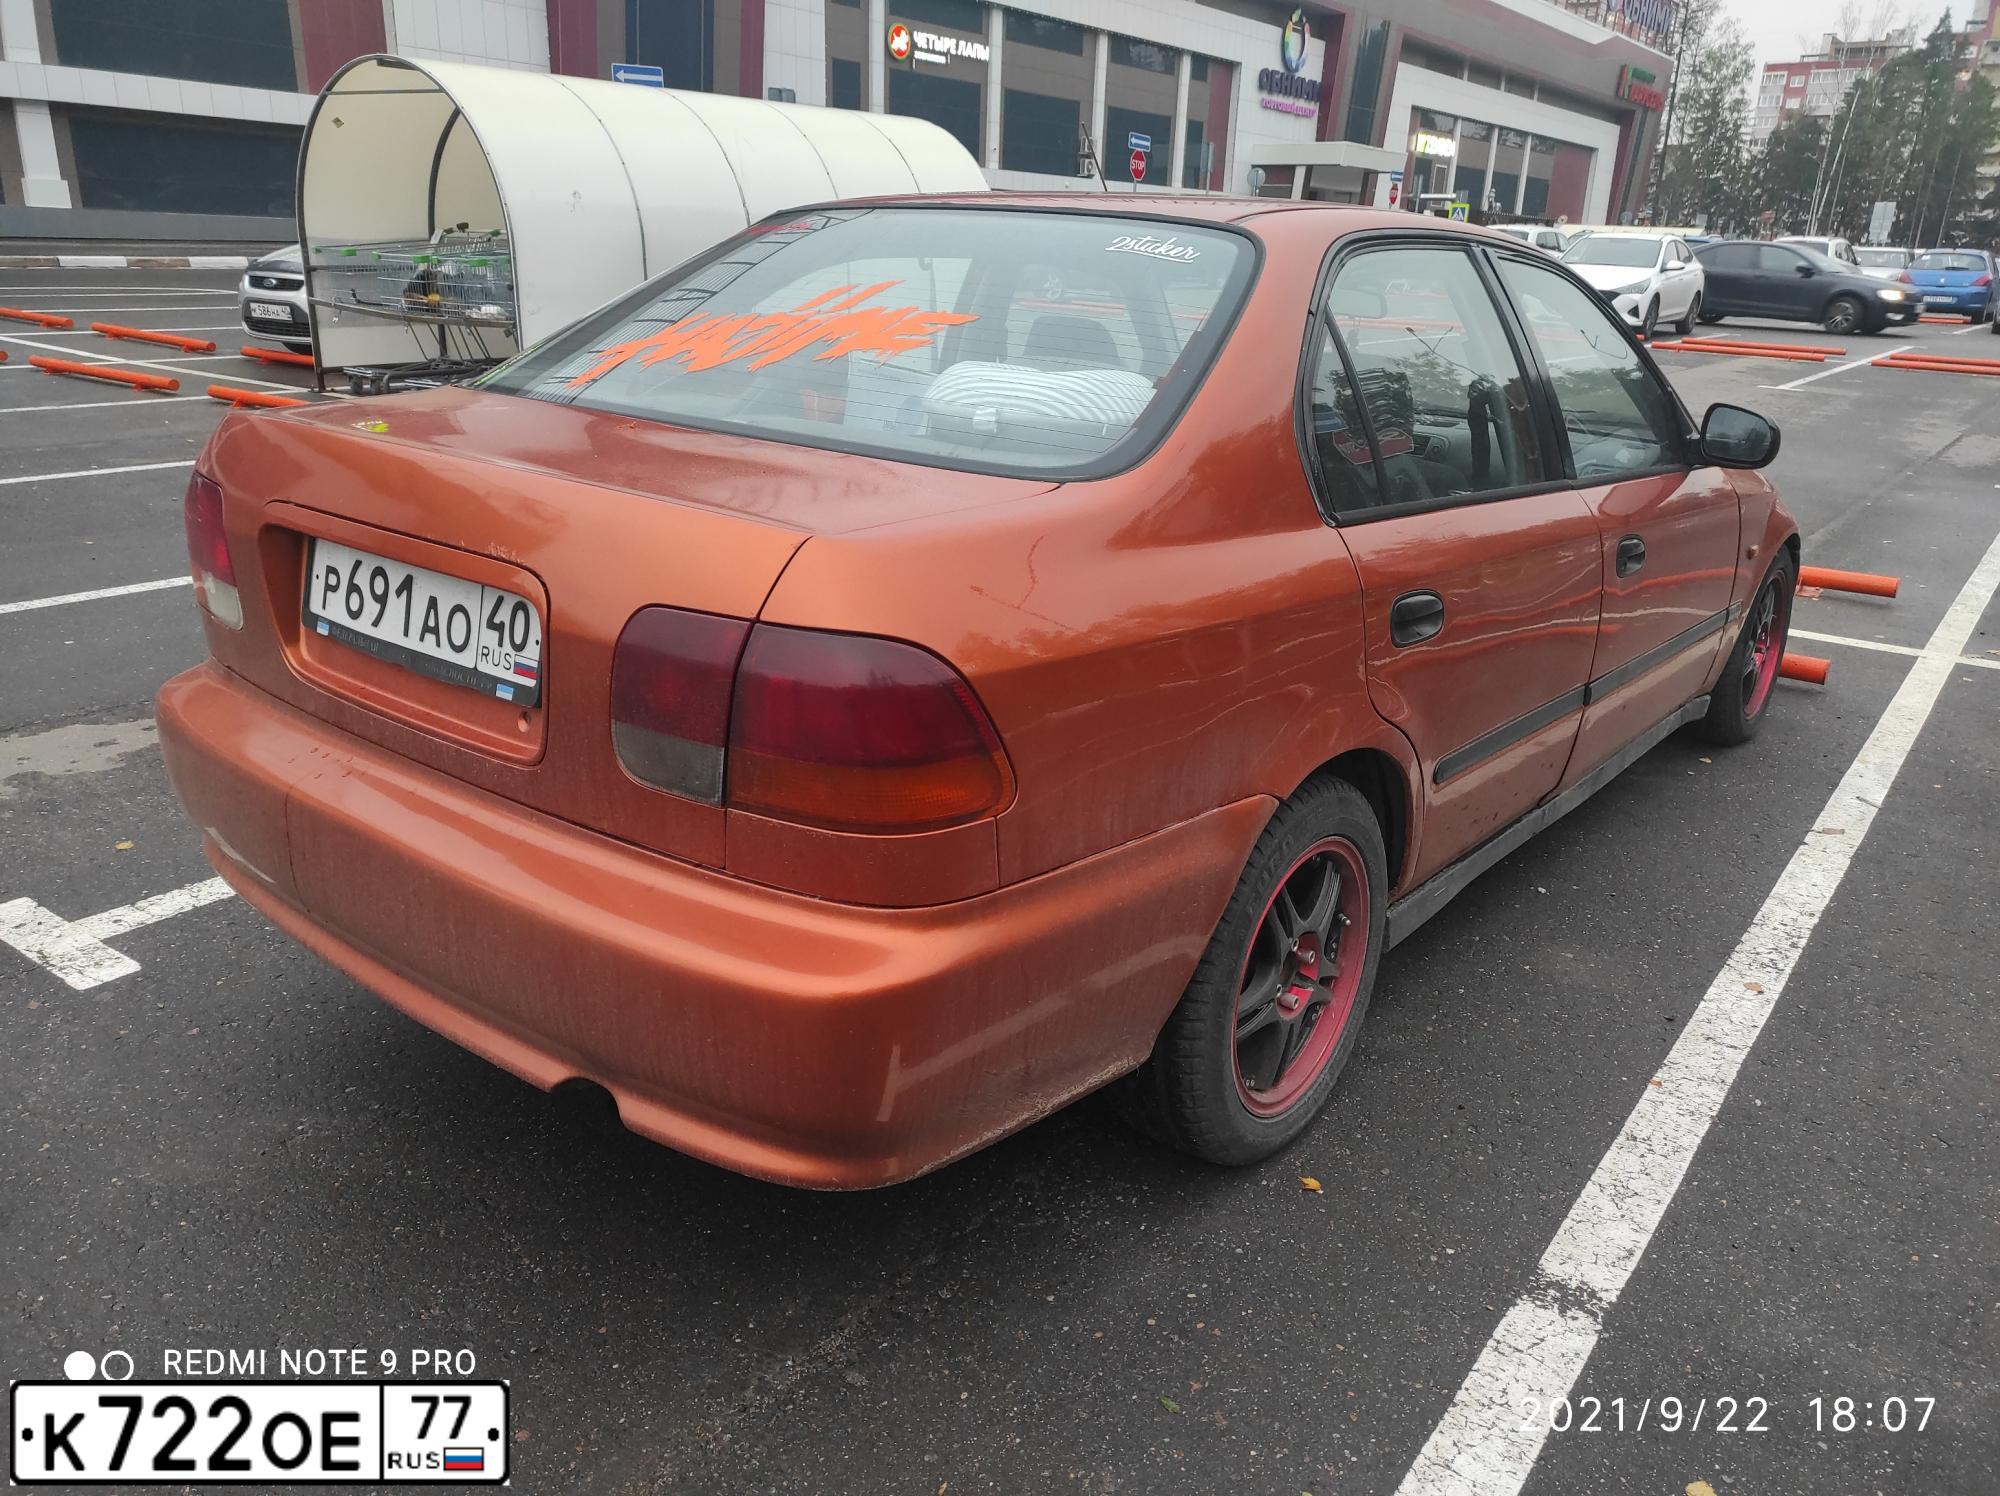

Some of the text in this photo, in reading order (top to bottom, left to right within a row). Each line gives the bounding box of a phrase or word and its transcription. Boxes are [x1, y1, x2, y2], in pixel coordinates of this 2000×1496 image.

[913, 31, 957, 55] ЧЕТЫРЕ
[957, 40, 990, 62] ЛАПЫ
[1131, 160, 1145, 171] STOP
[321, 559, 531, 654] Р691АО 40
[480, 645, 512, 671] RUS
